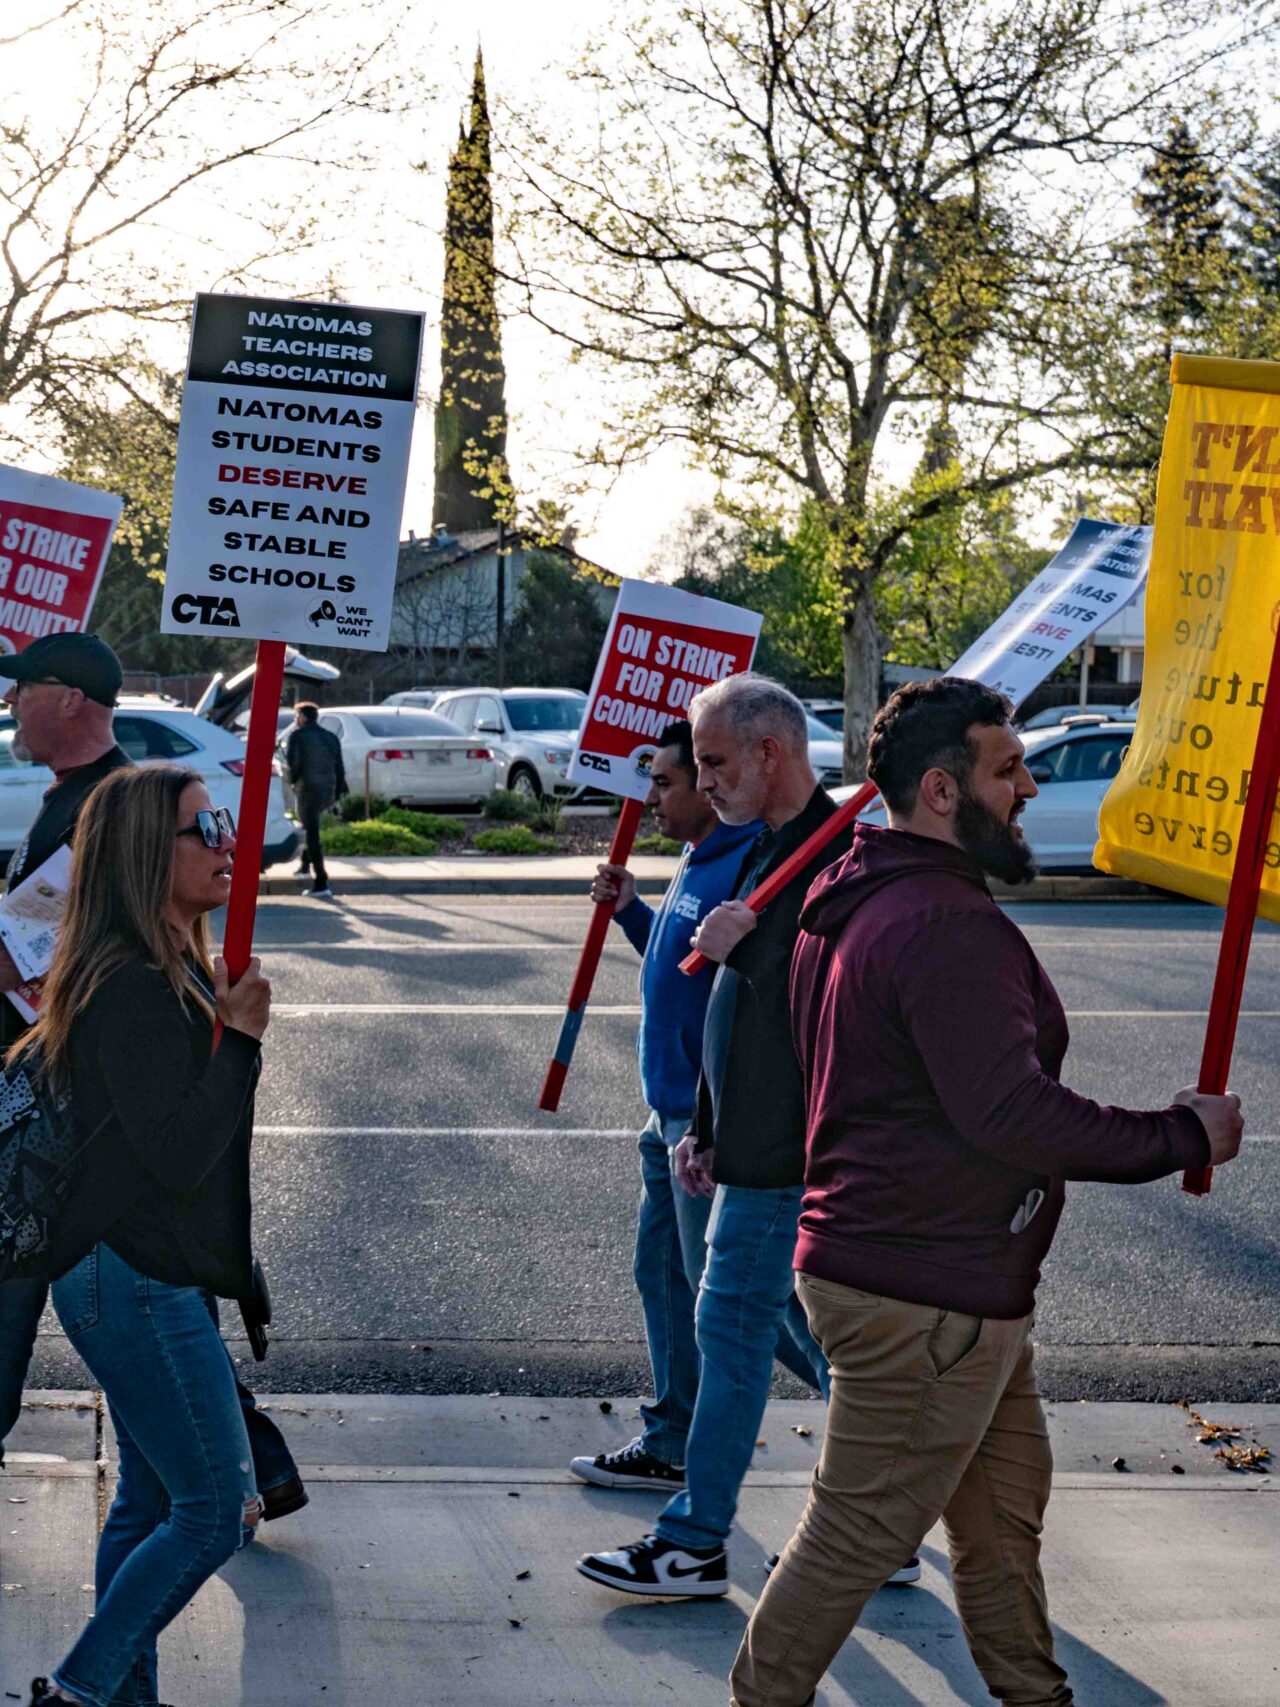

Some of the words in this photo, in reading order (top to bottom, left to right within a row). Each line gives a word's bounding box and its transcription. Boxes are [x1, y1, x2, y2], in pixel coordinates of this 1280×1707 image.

[248, 311, 373, 336] NATOMAS
[242, 336, 373, 362] TEACHERS
[222, 360, 387, 389] ASSOCIATION
[218, 397, 382, 430] NATOMAS
[212, 430, 381, 463] STUDENTS
[218, 464, 367, 495] DESERVE
[208, 497, 290, 521] SAFE
[296, 505, 370, 528] AND
[2, 518, 91, 571] STRIKE
[224, 532, 347, 559] STABLE
[15, 564, 68, 606] OUR
[209, 564, 356, 593] SCHOOLS
[171, 594, 240, 627] CTA
[346, 606, 367, 616] WE
[337, 627, 370, 637] WAIT
[617, 625, 652, 660] ON
[655, 635, 736, 681] STRIKE
[616, 663, 664, 701] FOR
[667, 678, 702, 711] OU
[579, 753, 611, 774] CTA
